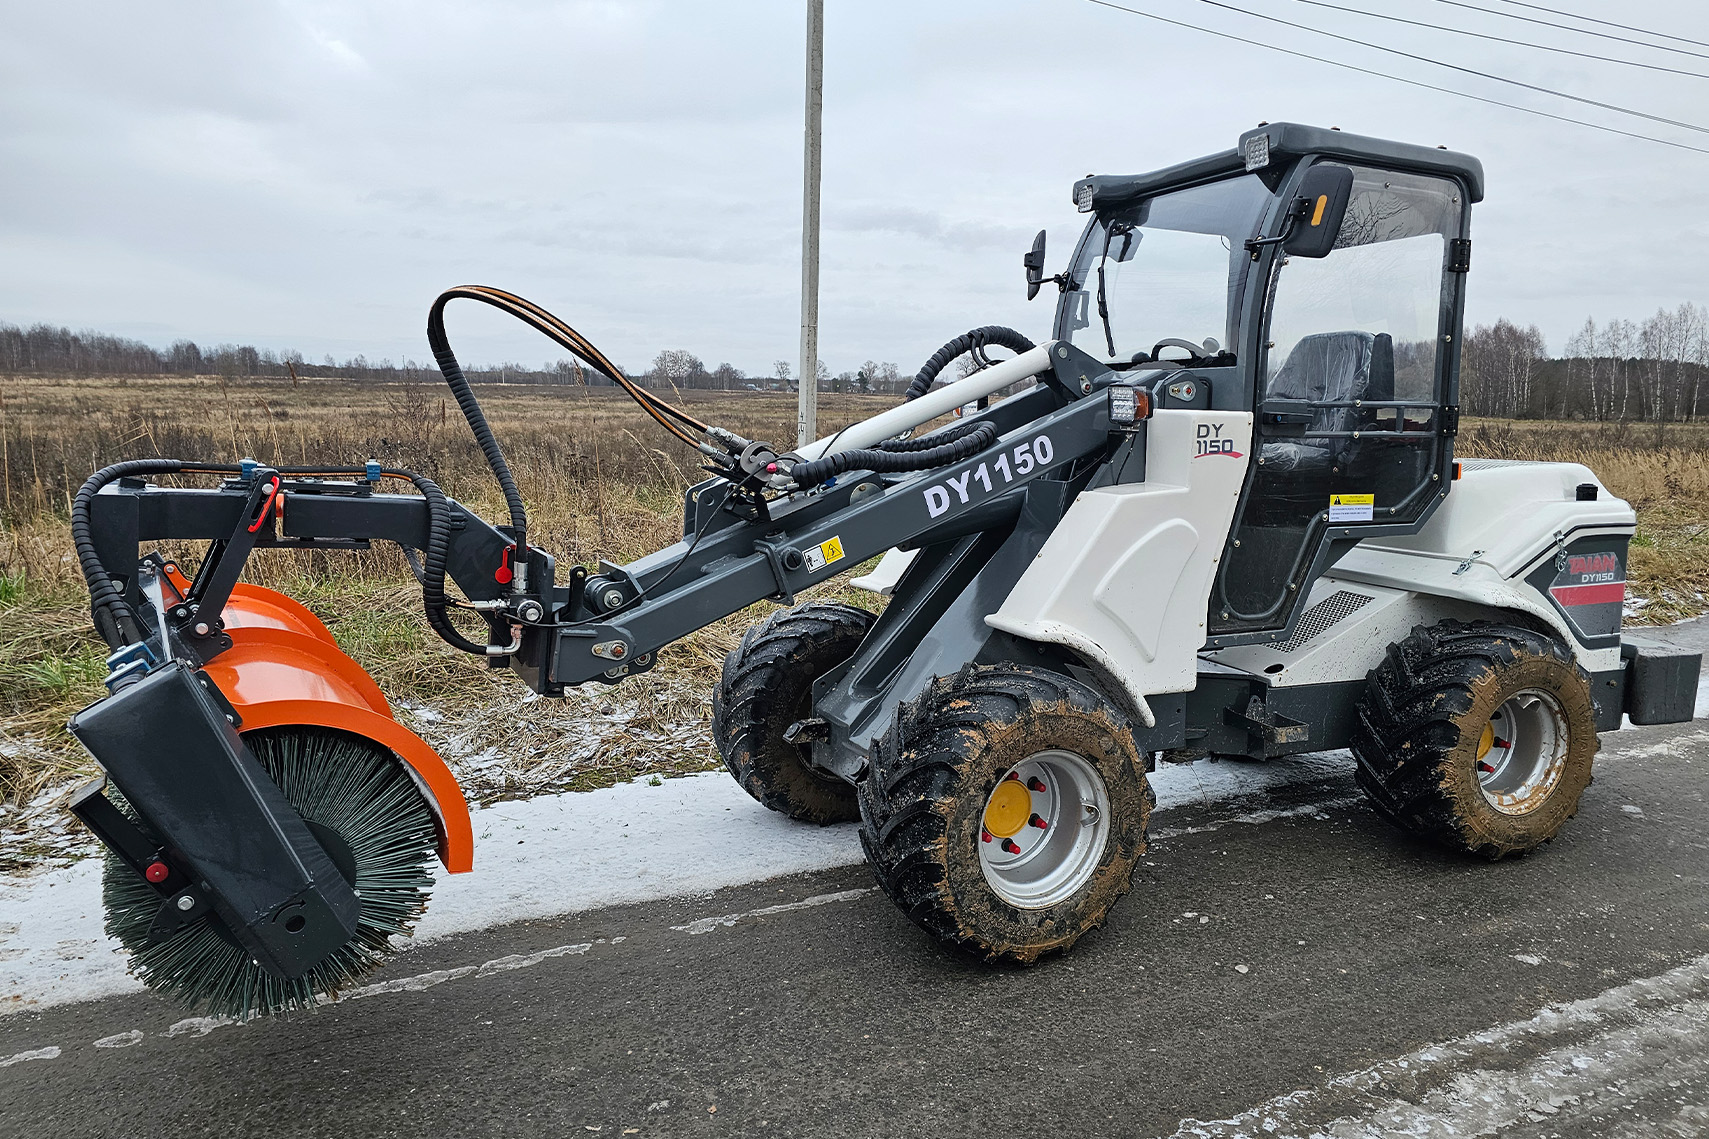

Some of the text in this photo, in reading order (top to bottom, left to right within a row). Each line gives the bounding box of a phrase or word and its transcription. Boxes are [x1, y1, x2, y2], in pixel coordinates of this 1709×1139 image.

[1197, 423, 1225, 439] DY
[1197, 439, 1233, 454] 1150
[922, 435, 1054, 519] DY1150
[1568, 555, 1616, 575] TAIAN
[1581, 572, 1614, 583] DY1150
